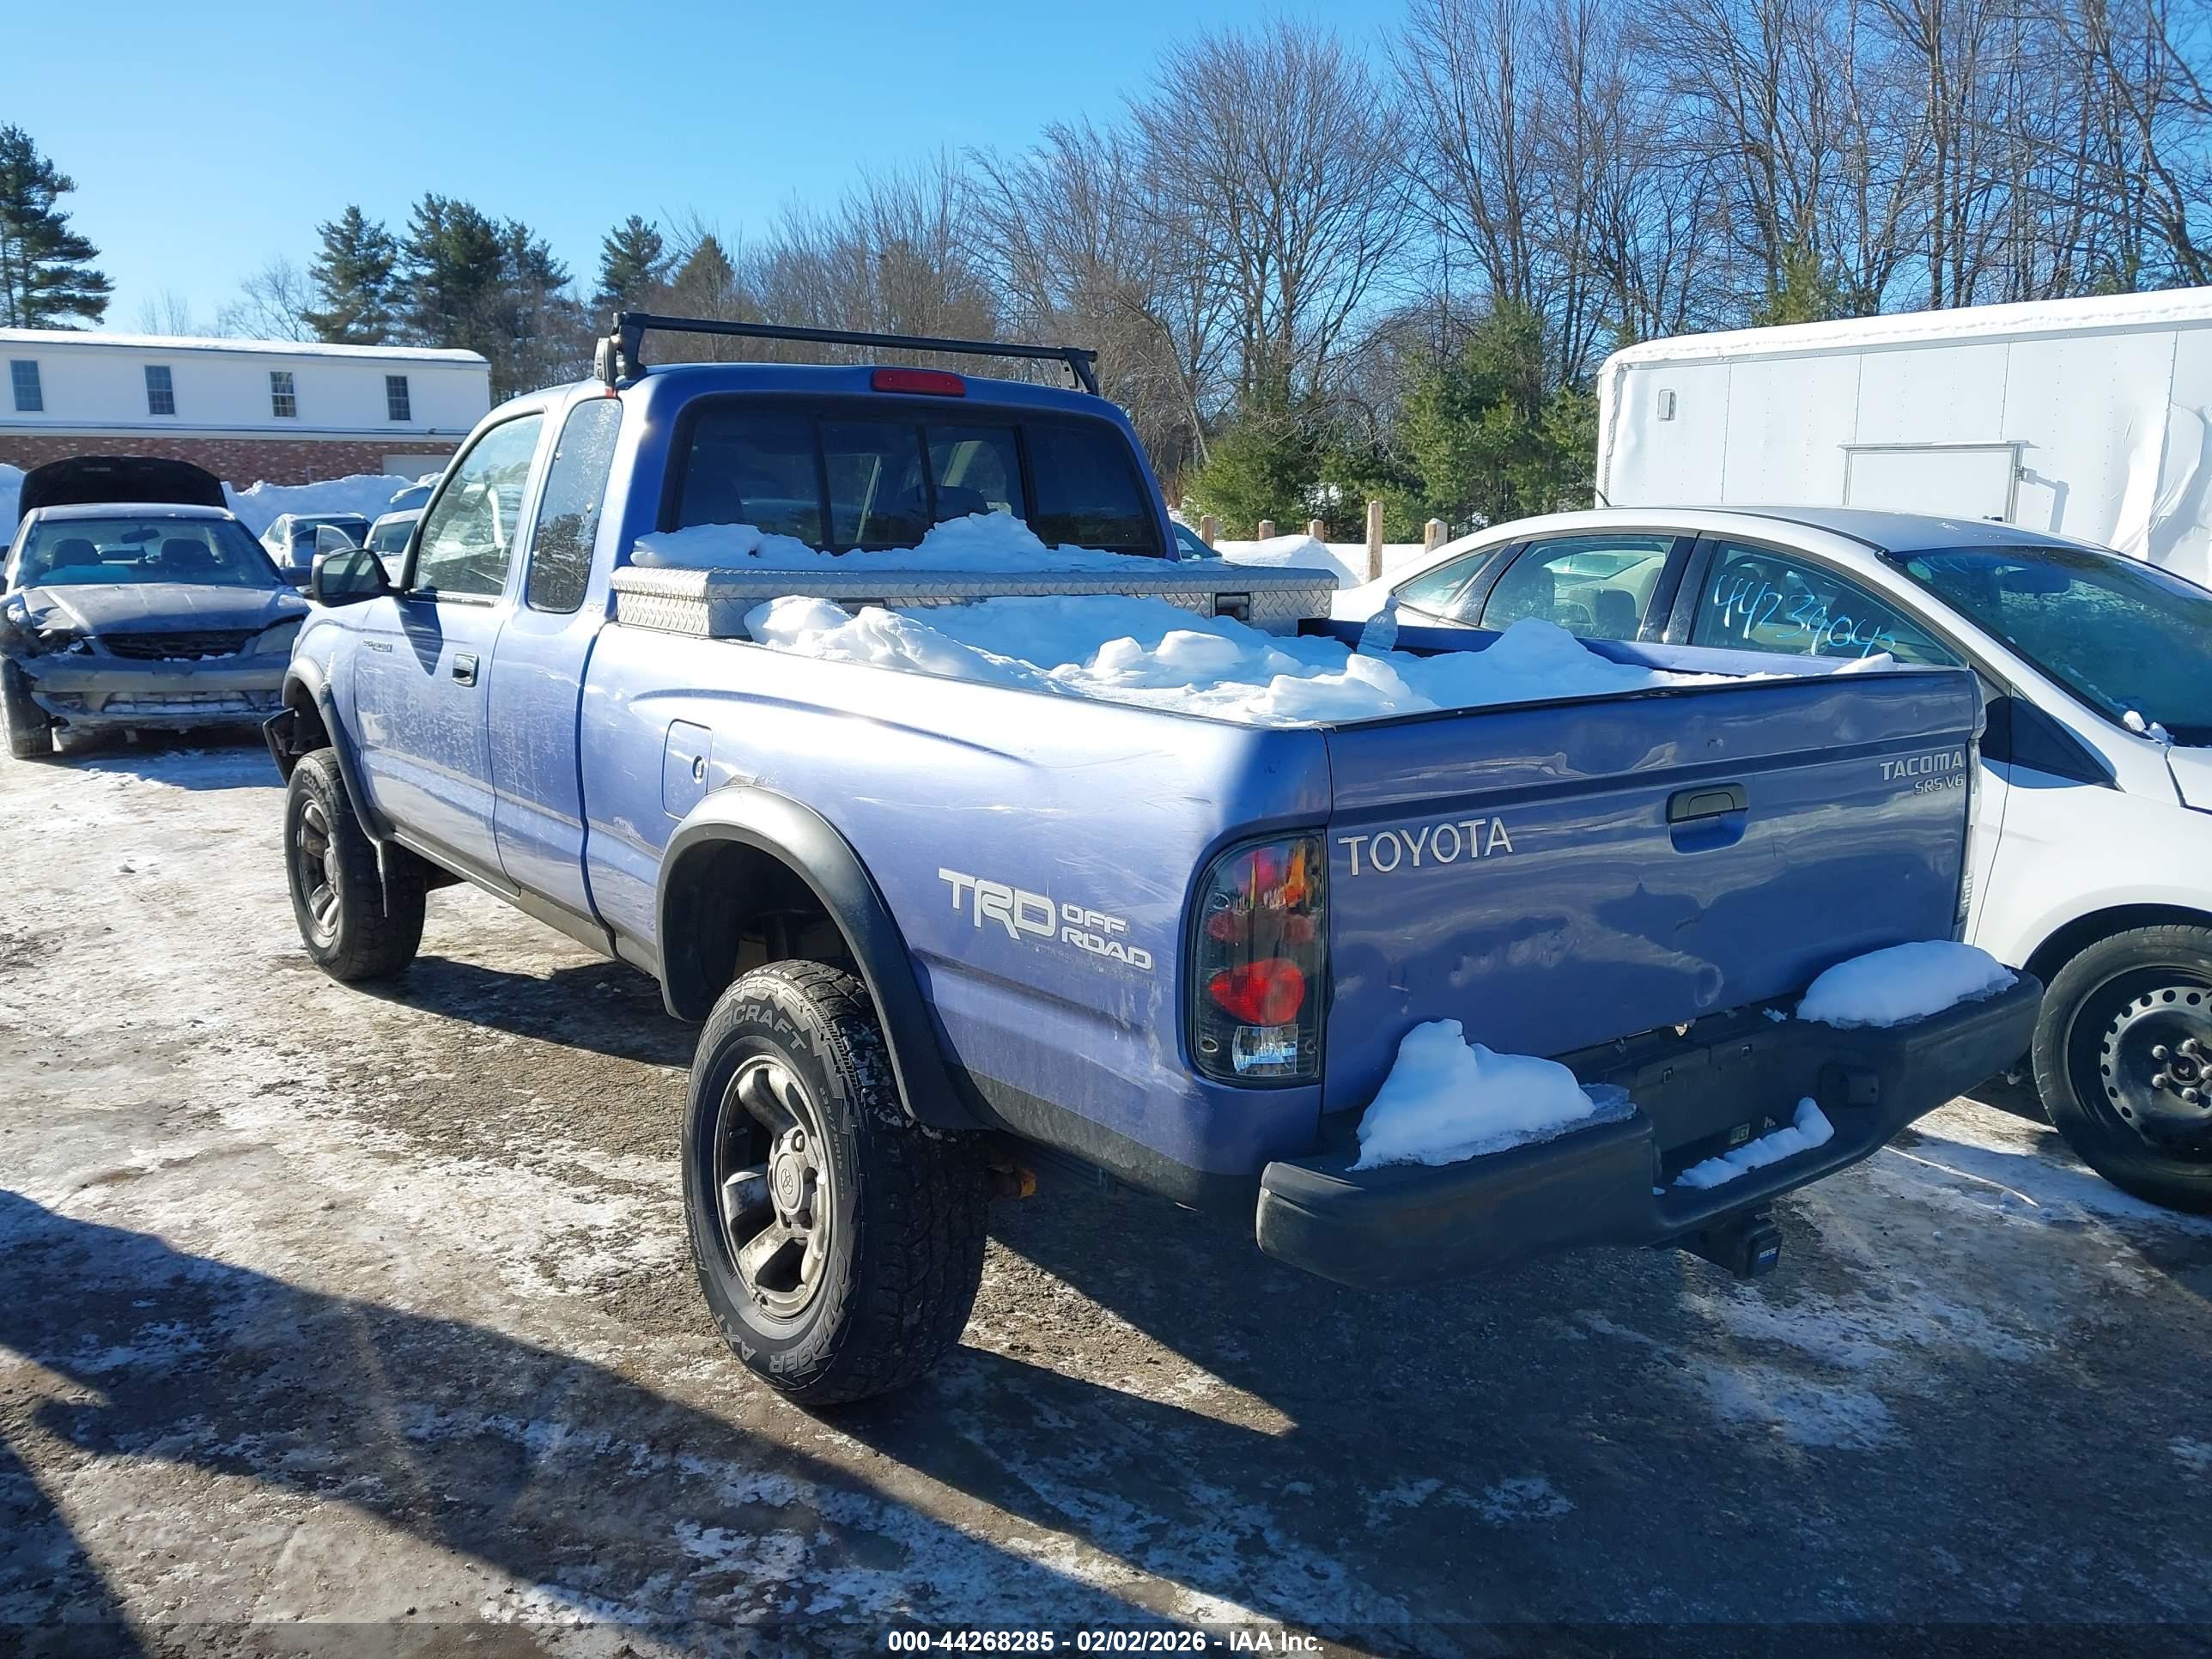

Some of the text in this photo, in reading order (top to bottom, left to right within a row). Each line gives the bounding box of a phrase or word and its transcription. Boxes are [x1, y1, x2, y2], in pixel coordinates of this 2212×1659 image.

[1879, 750, 1964, 781] TACOMA
[1914, 773, 1965, 794] SR5 V6
[1337, 817, 1514, 876] TOYOTA
[938, 867, 1057, 940] TRD
[1061, 902, 1127, 934] OFF
[1061, 926, 1152, 970] ROAD
[713, 1246, 848, 1373] COURSER AXT
